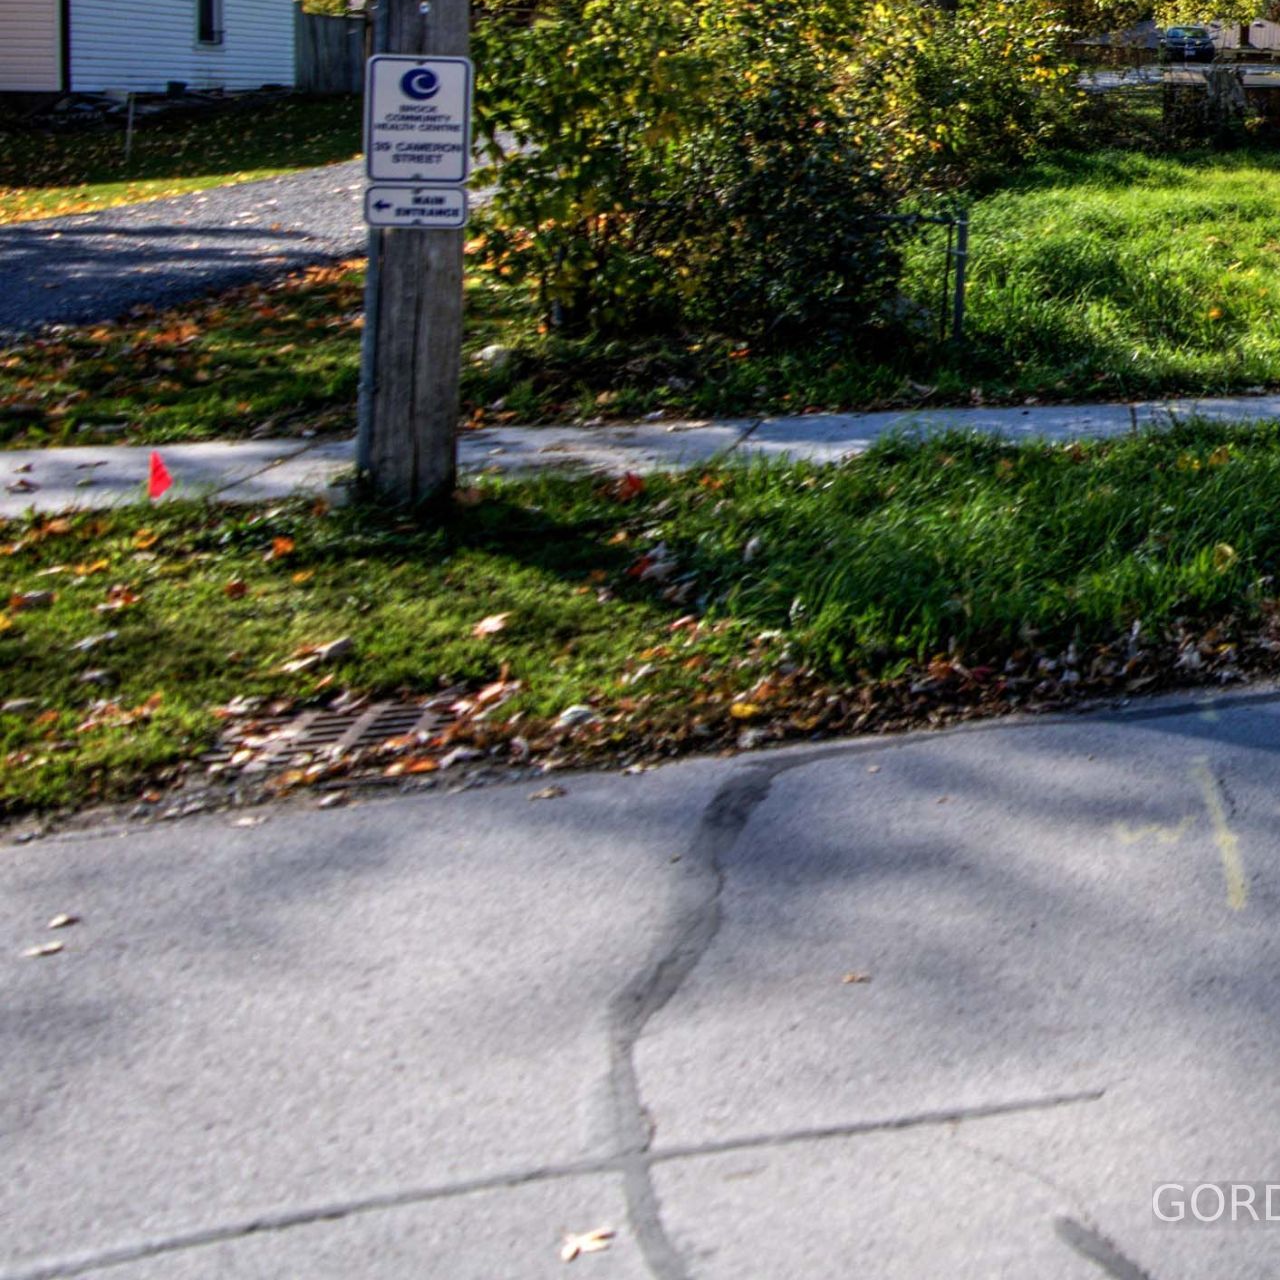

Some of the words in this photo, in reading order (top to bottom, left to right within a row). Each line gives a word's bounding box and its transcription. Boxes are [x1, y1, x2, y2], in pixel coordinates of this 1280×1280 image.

[395, 141, 463, 153] CAMERON
[392, 154, 443, 164] STREET
[412, 196, 446, 206] MAIN
[395, 207, 459, 218] ENTRANCE
